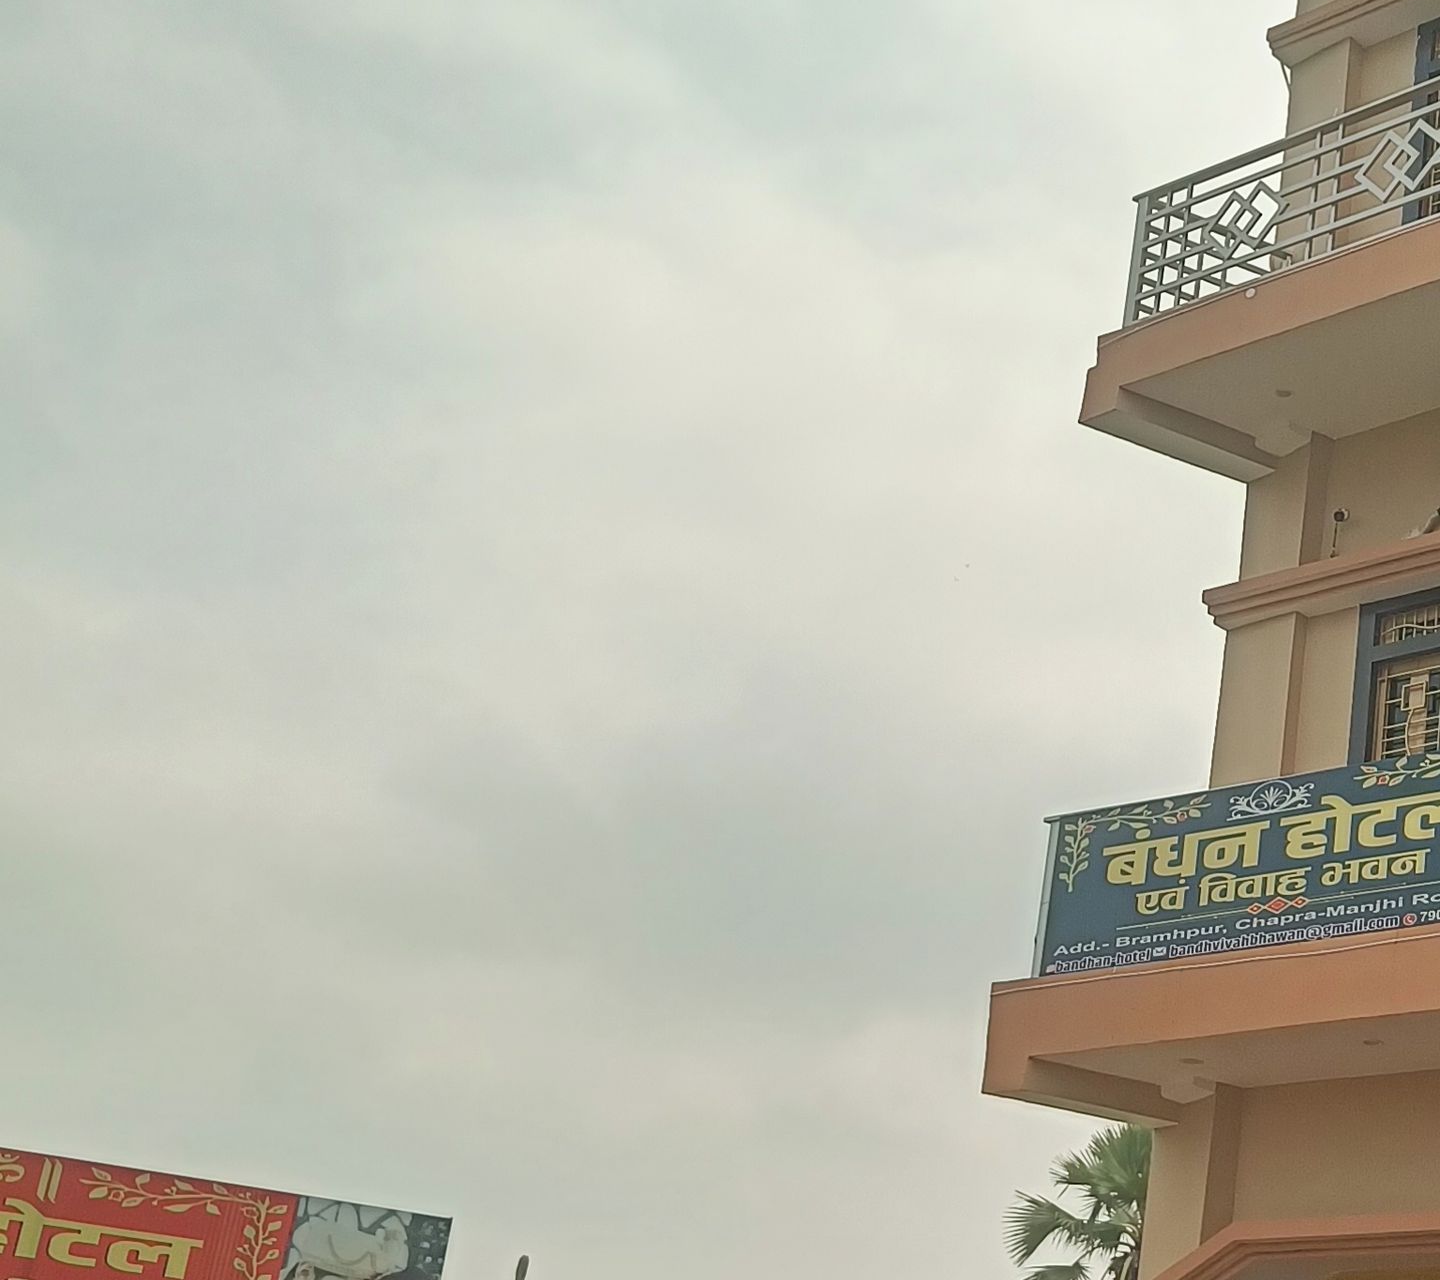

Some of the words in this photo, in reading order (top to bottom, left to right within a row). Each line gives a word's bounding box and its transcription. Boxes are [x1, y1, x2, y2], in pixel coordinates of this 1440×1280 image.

[1103, 821, 1270, 886] बंधन
[1136, 874, 1189, 915] एवं
[1199, 864, 1311, 907] विवाह
[1321, 848, 1431, 887] भवन
[1116, 923, 1228, 948] Bramhpur,
[1235, 896, 1404, 931] Chapra-Manjhi
[1054, 950, 1151, 974] bandhan-hotel
